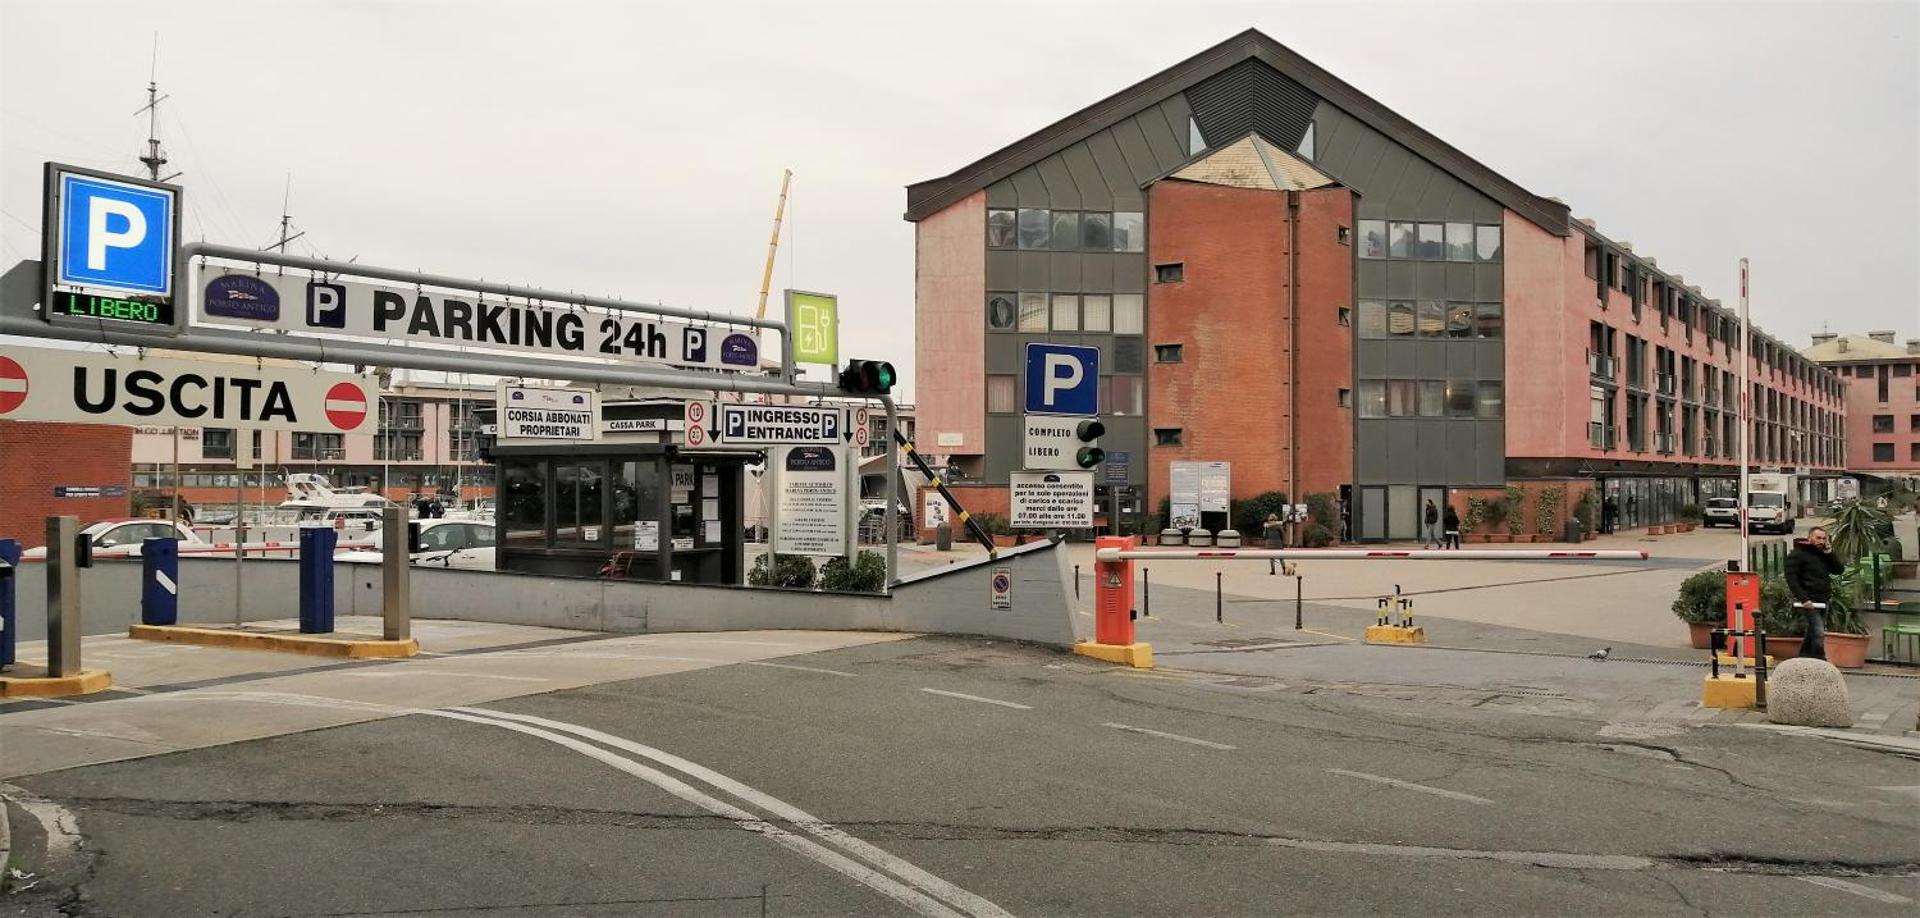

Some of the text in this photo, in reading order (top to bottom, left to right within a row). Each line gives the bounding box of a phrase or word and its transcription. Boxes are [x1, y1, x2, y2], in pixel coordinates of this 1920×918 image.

[88, 195, 147, 271] P
[70, 294, 158, 321] LIBERO
[313, 286, 339, 324] P
[373, 290, 667, 359] PARKING 24h
[687, 330, 702, 360] P
[1043, 352, 1084, 406] P
[73, 366, 298, 423] USCITA
[508, 410, 590, 425] CORSIA ABBONATI
[609, 420, 656, 430] CASSA PARK
[728, 412, 742, 435] P
[747, 409, 820, 425] INGRESSO
[824, 415, 836, 436] P
[520, 424, 580, 437] PROPRIETARI
[747, 426, 820, 440] ENTRANCE
[1028, 427, 1071, 438] COMPLETO
[1028, 447, 1060, 457] LIBERO
